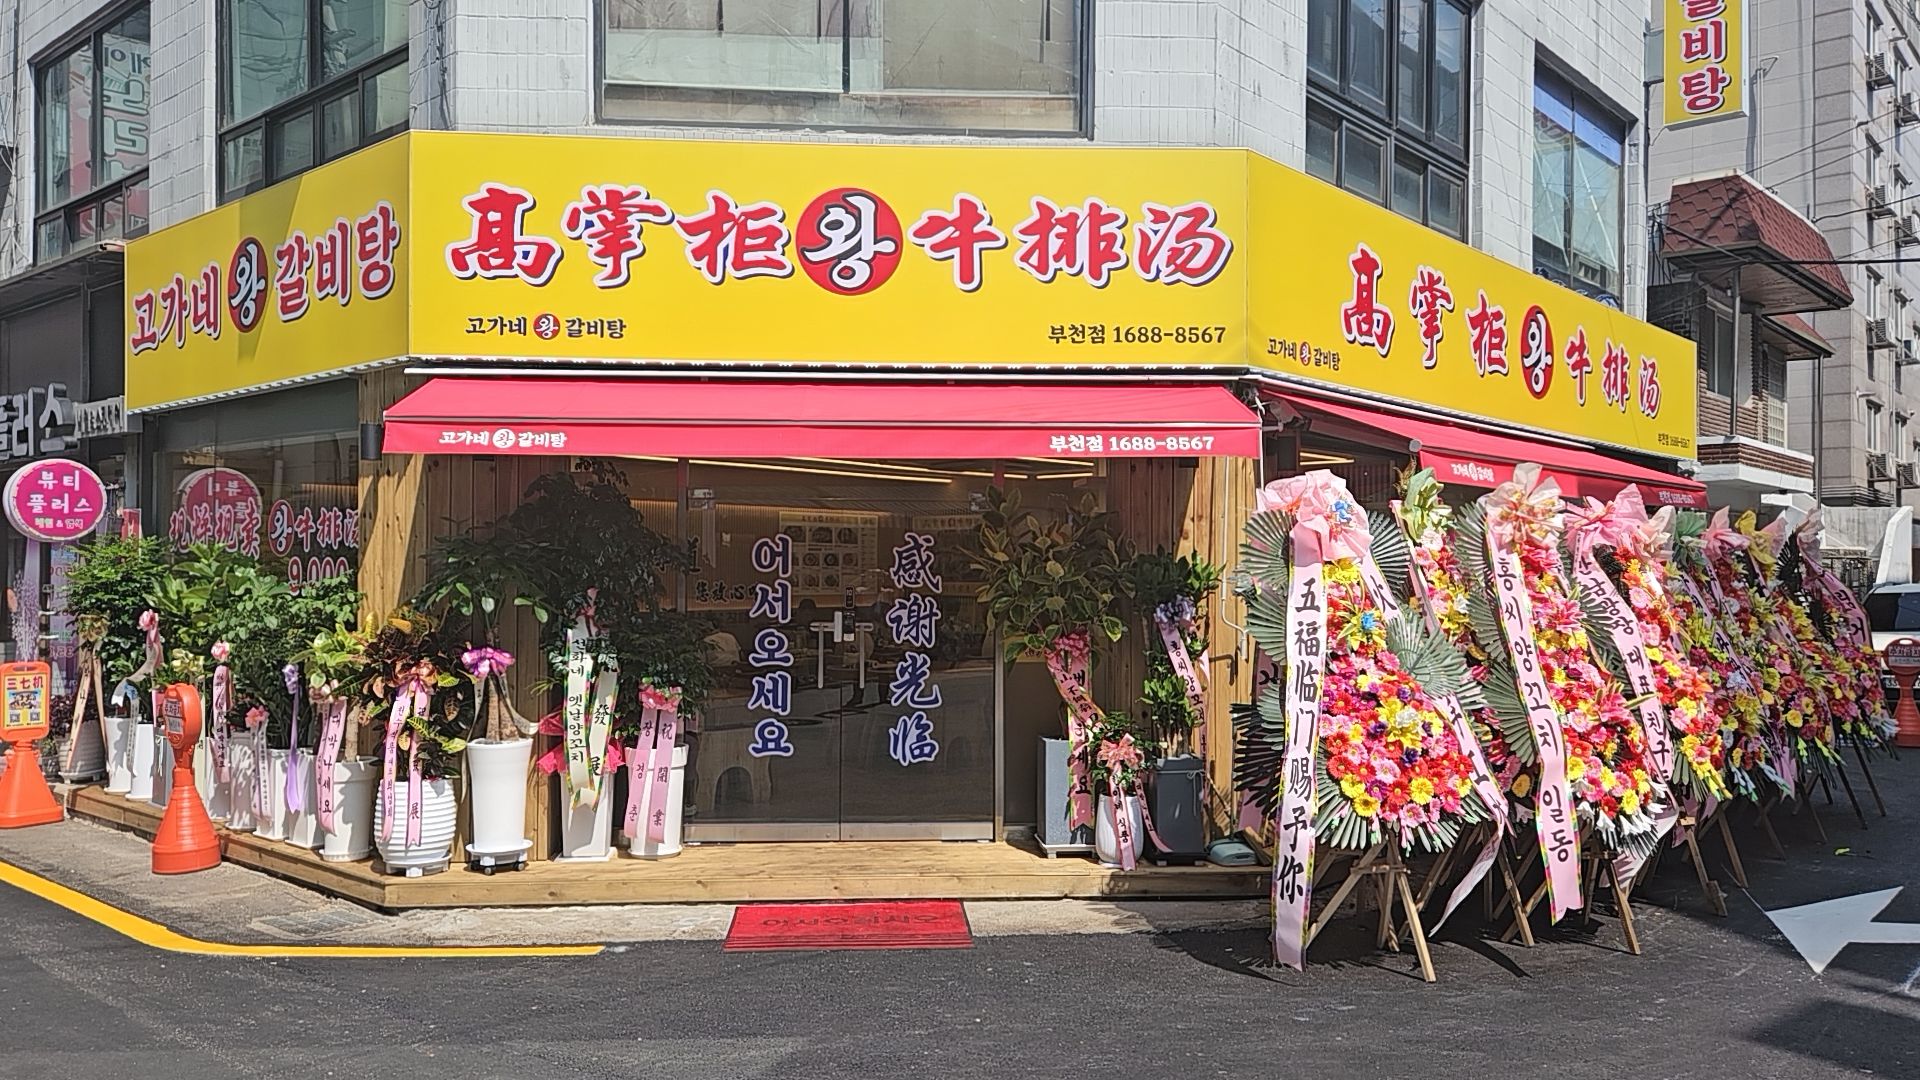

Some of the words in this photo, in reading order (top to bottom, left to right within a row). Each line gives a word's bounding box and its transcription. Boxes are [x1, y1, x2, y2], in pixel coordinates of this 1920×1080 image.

[799, 190, 901, 293] 왕
[132, 261, 221, 354] 고가네
[229, 240, 267, 329] 왕
[275, 201, 399, 322] 갈비탕
[465, 316, 527, 336] 고가네
[534, 314, 560, 339] 왕
[565, 317, 627, 338] 갈비탕
[1048, 325, 1106, 344] 부천점
[1113, 326, 1226, 344] 1688-8567
[1521, 307, 1554, 397] 왕
[1267, 338, 1297, 361] 고가네
[1300, 341, 1311, 366] 왕
[1314, 347, 1340, 371] 갈비탕
[439, 431, 489, 446] 고가네
[493, 429, 515, 448] 왕
[518, 432, 567, 447] 갈비탕
[1050, 434, 1103, 452] 부천점
[1109, 436, 1214, 451] 1688-8567
[27, 493, 93, 513] 플러스
[38, 470, 80, 491] 뷰티
[269, 501, 294, 555] 왕
[570, 638, 588, 677] 선화네
[748, 533, 794, 758] 어서오세요
[886, 532, 942, 767] 感谢光临
[7, 675, 43, 690] 三七机
[568, 694, 586, 764] 옛날양꼬치
[1498, 559, 1558, 754] 홍씨양꼬치
[1541, 789, 1574, 862] 일동
[321, 711, 341, 814] 대박나세요
[1277, 579, 1320, 904] 五福临门赐予你
